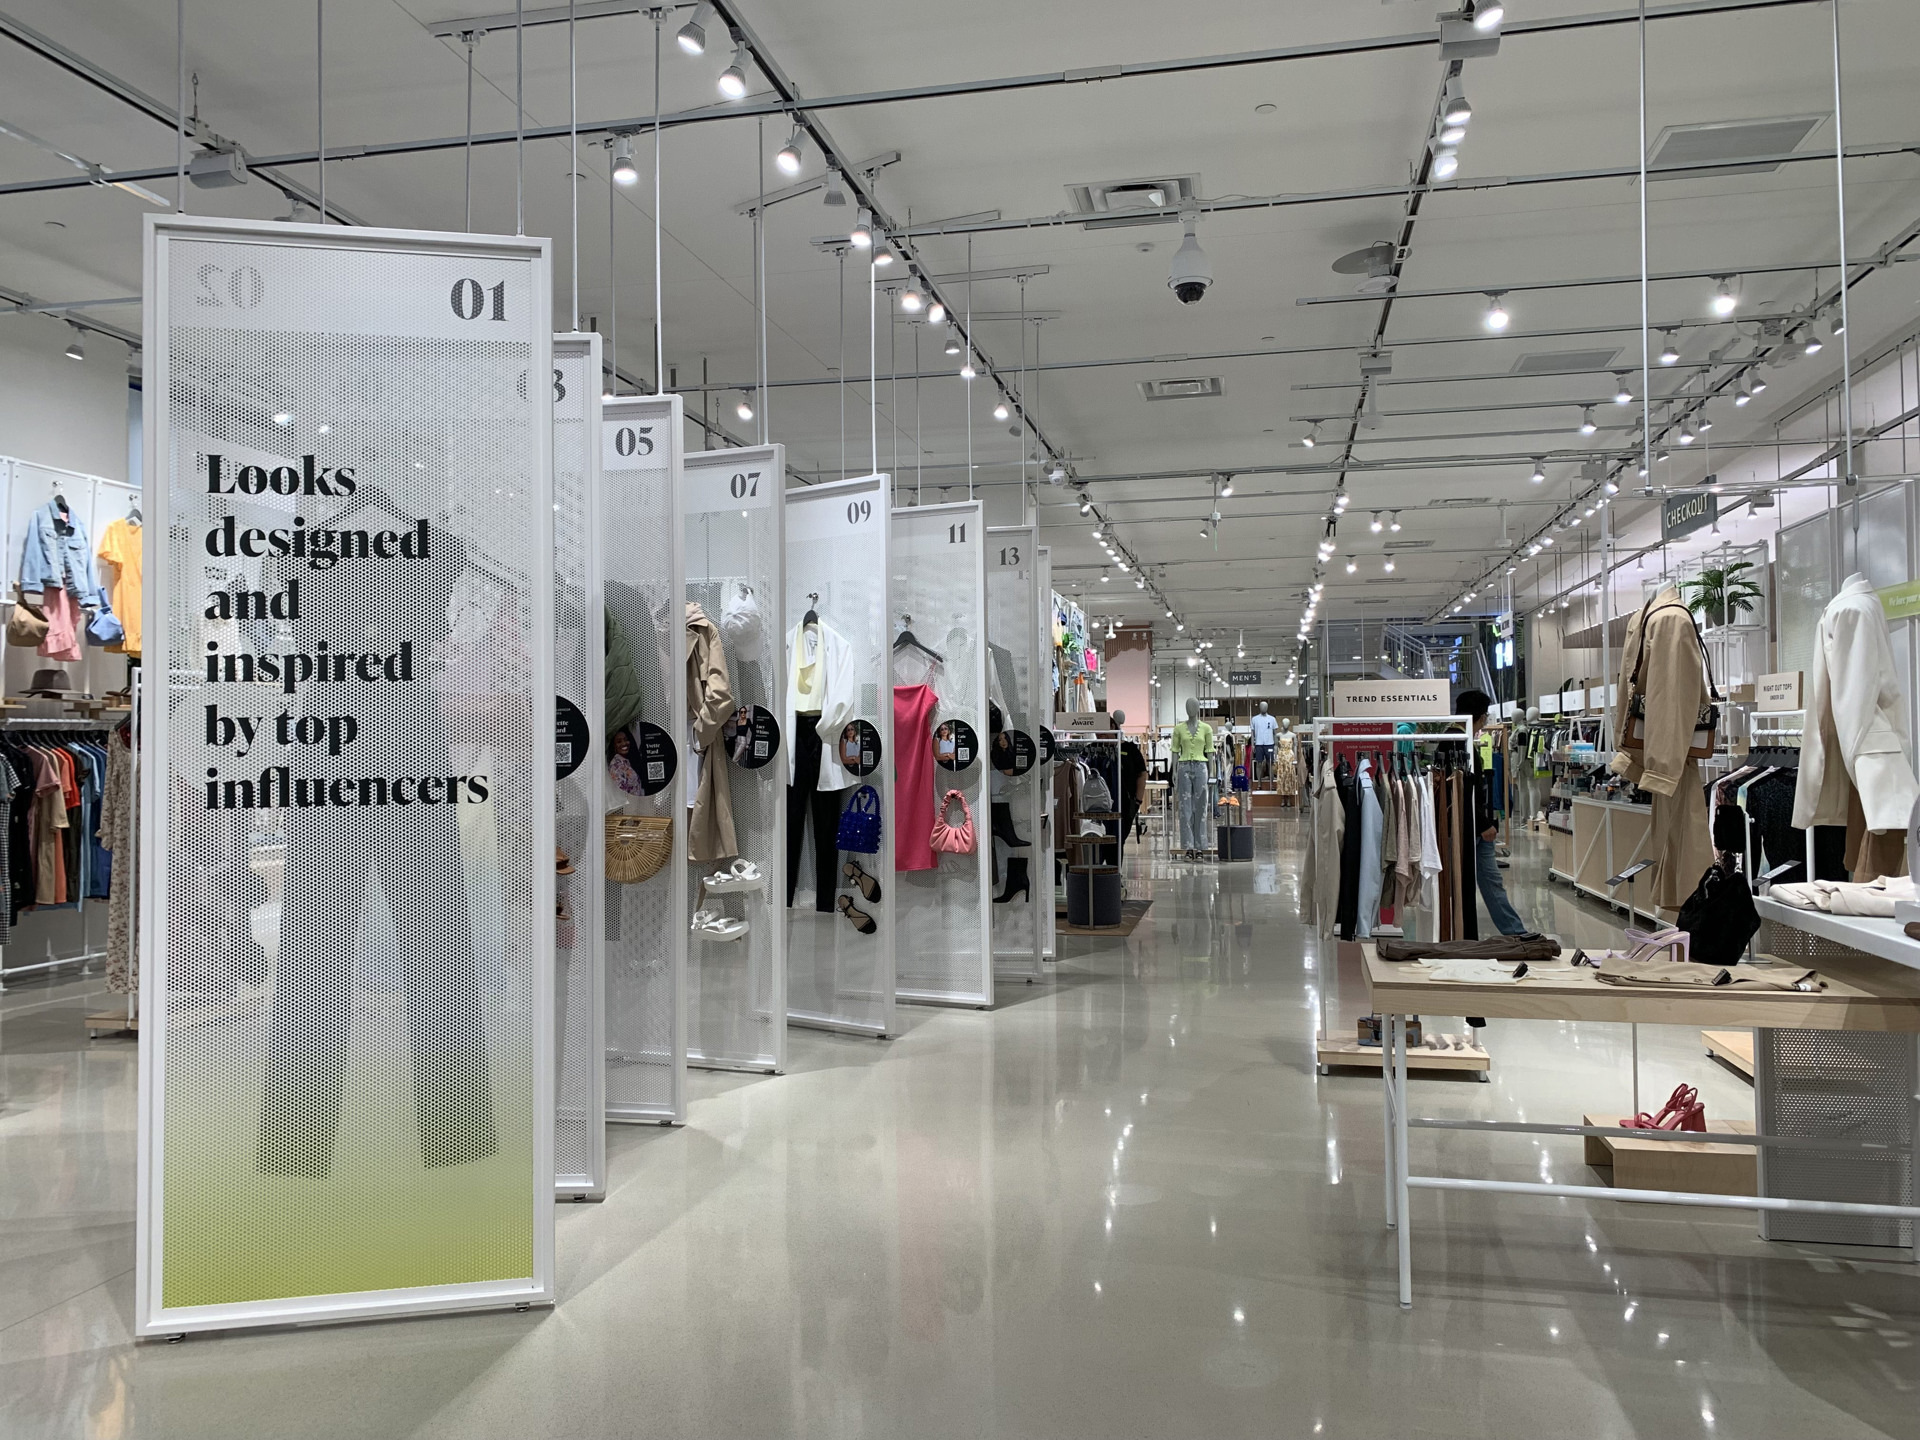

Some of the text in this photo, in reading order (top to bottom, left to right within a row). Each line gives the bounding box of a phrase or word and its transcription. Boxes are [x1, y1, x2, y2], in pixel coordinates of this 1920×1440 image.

[450, 277, 509, 322] 01
[615, 427, 654, 457] 05
[205, 454, 357, 497] Looks
[730, 472, 761, 499] 07
[847, 500, 872, 525] 09
[1666, 492, 1709, 529] CHECKOUT
[205, 515, 431, 571] designed
[948, 522, 967, 544] 11
[1000, 546, 1020, 566] 13
[204, 578, 301, 621] and
[205, 640, 414, 694] inspired
[1232, 674, 1257, 682] MEN'S
[1346, 694, 1438, 703] TREND ESSENTIALS
[205, 704, 358, 758] by top
[1072, 718, 1095, 726] Aware
[205, 766, 490, 811] influencers
